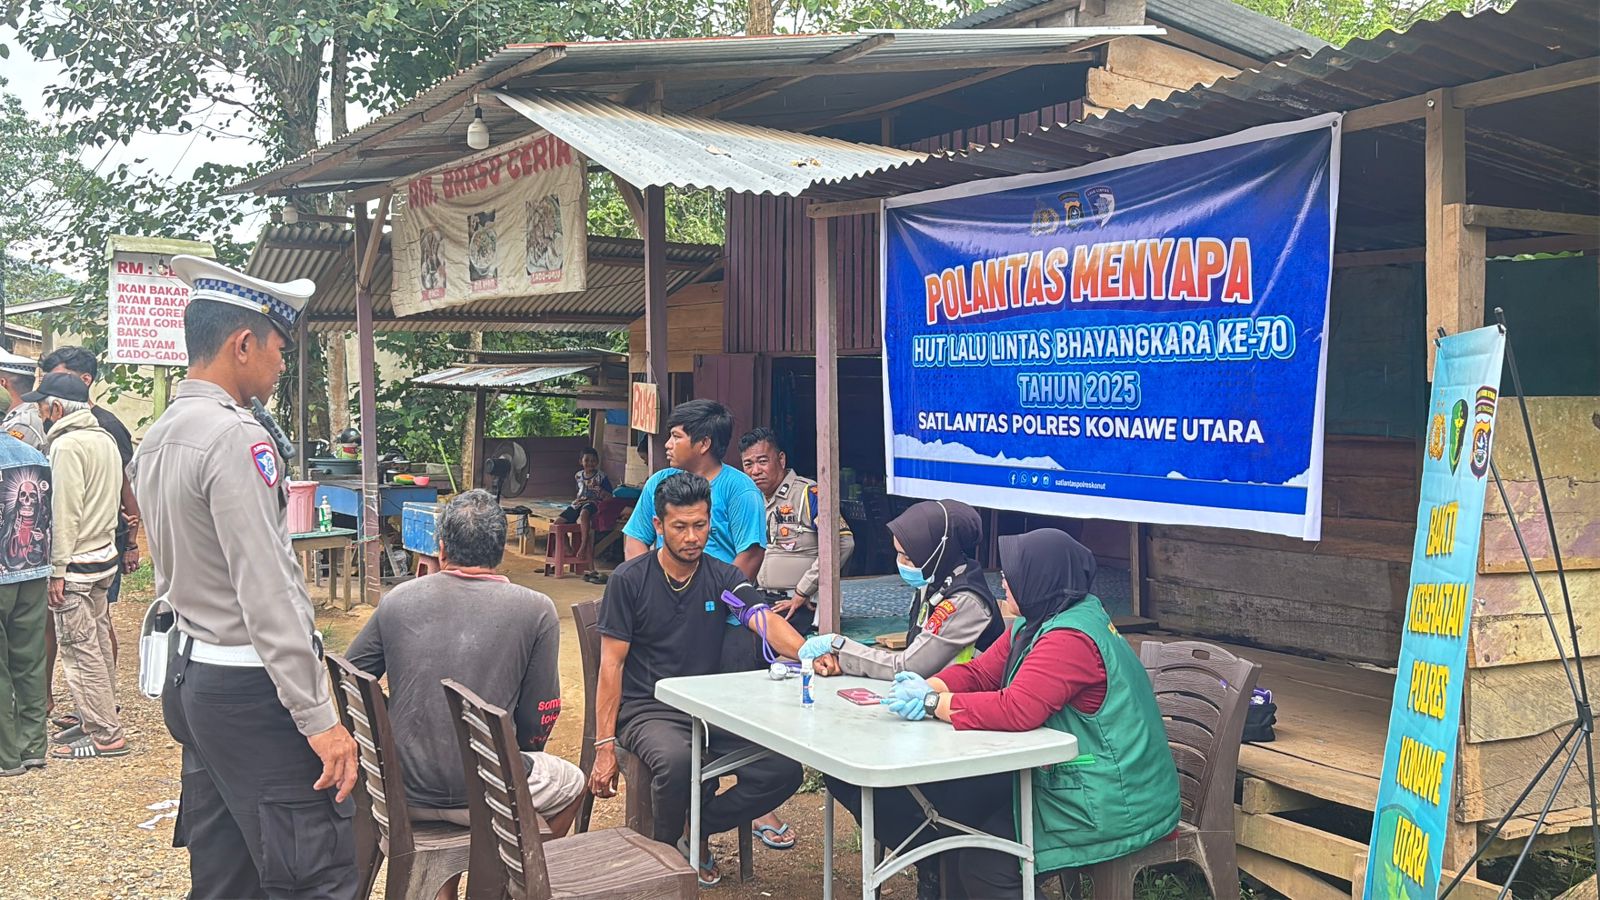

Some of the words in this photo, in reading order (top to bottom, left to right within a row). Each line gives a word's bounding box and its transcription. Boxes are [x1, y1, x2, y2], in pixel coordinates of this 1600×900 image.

[117, 261, 144, 275] RM
[925, 246, 1068, 325] POLANTAS
[1071, 237, 1253, 304] MENYAPA
[117, 284, 146, 293] IKAN
[149, 286, 189, 296] BAKAR
[117, 295, 151, 305] AYAM
[117, 306, 146, 315] IKAN
[117, 317, 151, 327] AYAM
[117, 328, 158, 338] BAKSO
[117, 339, 140, 348] MIE
[142, 341, 175, 350] AYAM
[913, 335, 947, 367] HUT
[949, 333, 990, 366] LALU
[990, 330, 1052, 366] LINTAS
[1053, 321, 1216, 364] BHAYANGKARA
[1217, 315, 1296, 361] KE-70
[117, 350, 187, 361] GADO-GADO
[633, 384, 656, 431] BUKA
[1017, 373, 1084, 408] TAHUN
[1085, 371, 1141, 409] 2025
[918, 411, 1008, 434] SATLANTAS
[1012, 414, 1081, 437] POLRES
[1085, 416, 1177, 440] KONAWE
[1182, 418, 1264, 444] UTARA
[1425, 501, 1460, 558] BAKTI
[1408, 583, 1470, 638] KESEHATAN
[1408, 660, 1449, 720] POLRES
[1396, 736, 1446, 806] KONAWE
[1392, 815, 1430, 888] UTARA
